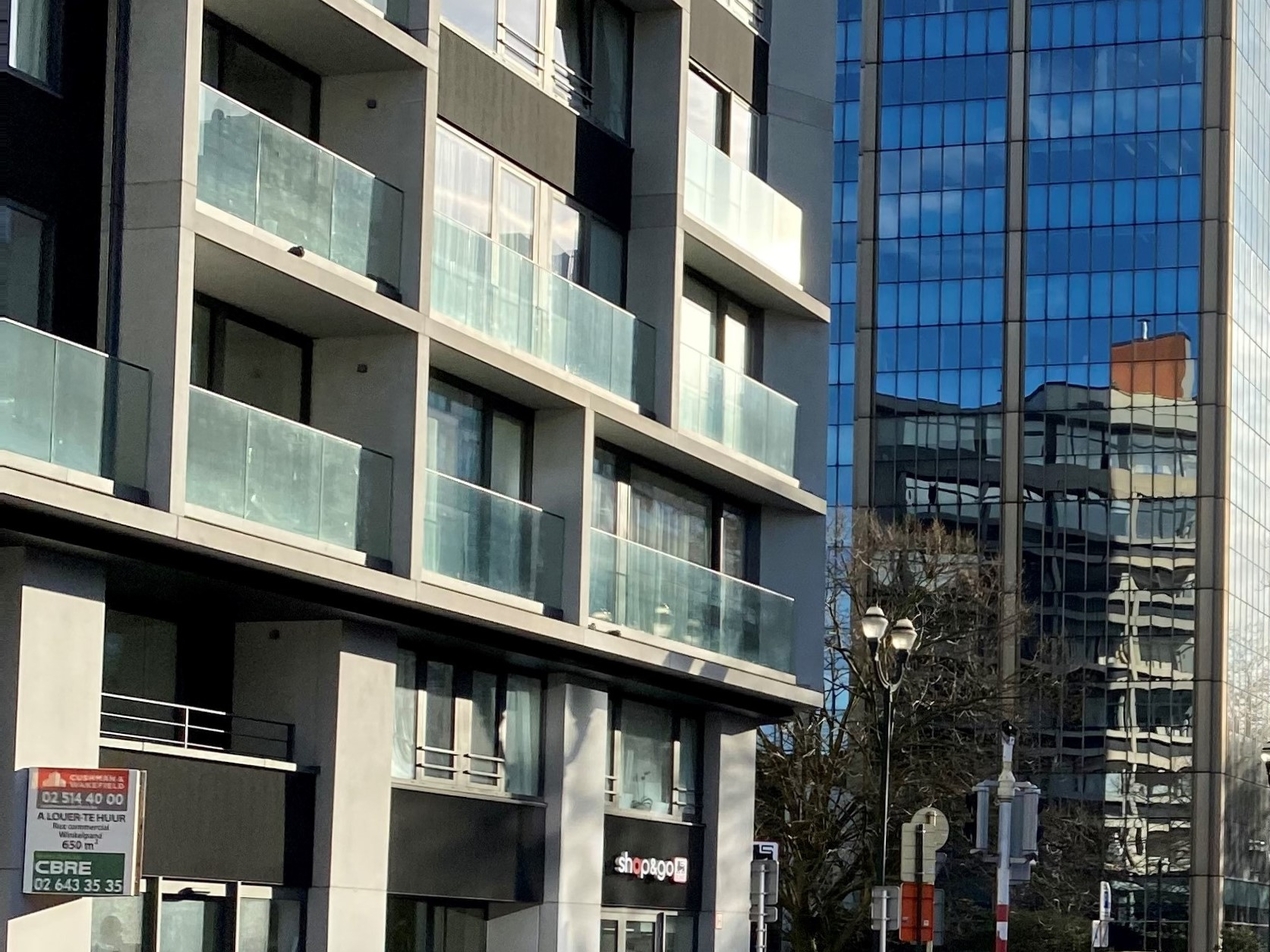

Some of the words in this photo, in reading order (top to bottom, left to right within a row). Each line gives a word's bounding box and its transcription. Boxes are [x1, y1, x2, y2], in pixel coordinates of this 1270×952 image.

[69, 781, 125, 790] WAKEFIELD
[42, 791, 59, 804] 02
[61, 791, 82, 804] 514
[86, 792, 103, 805] 40
[106, 793, 124, 806] 00
[37, 812, 45, 820] A
[96, 813, 126, 823] HUUR
[62, 840, 82, 850] 650
[34, 860, 92, 876] CBRE
[33, 878, 51, 891] 02
[54, 878, 80, 892] 643
[83, 879, 102, 893] 35
[104, 880, 123, 893] 35
